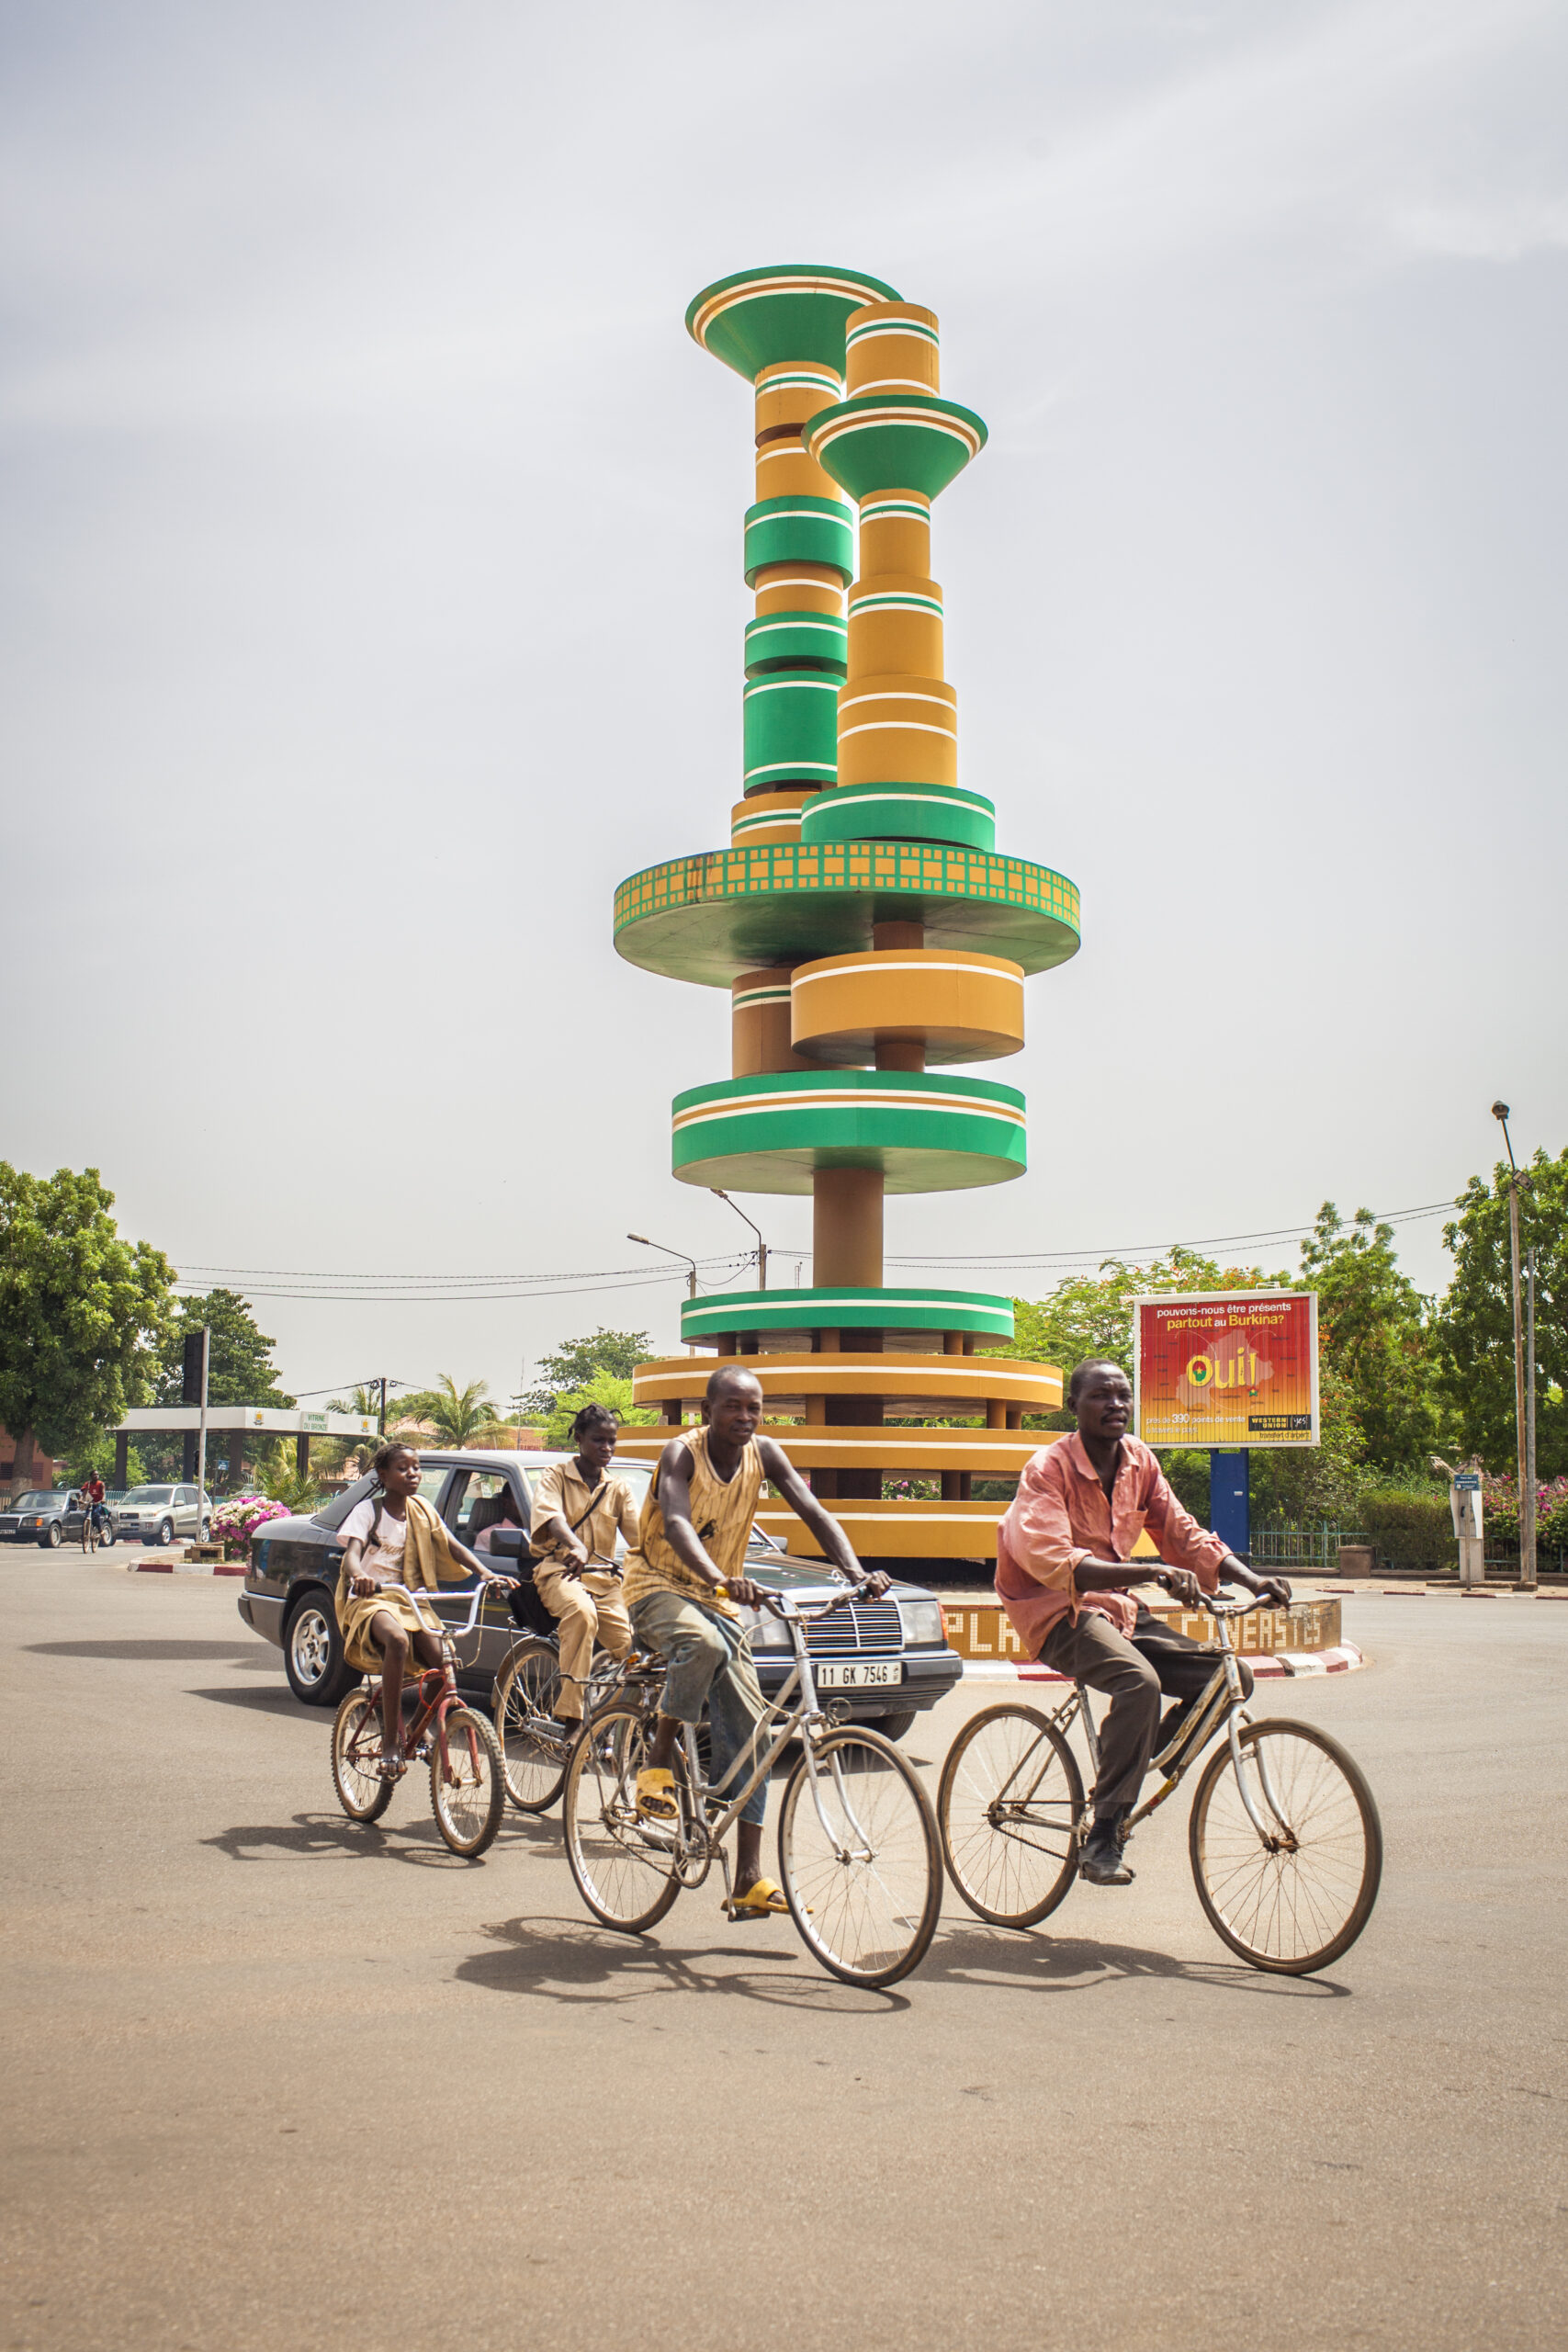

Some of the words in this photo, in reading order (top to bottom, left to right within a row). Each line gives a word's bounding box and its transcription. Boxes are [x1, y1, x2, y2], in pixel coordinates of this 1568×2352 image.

[1156, 1306, 1225, 1319] pouvons-nous
[1227, 1304, 1247, 1314] être
[1248, 1302, 1292, 1315] présents
[1167, 1316, 1213, 1331] partout
[1213, 1318, 1227, 1327] au
[1228, 1313, 1284, 1327] Burkina?
[1186, 1346, 1258, 1397] Oui!
[308, 1414, 326, 1422] VITRINE
[1171, 1413, 1190, 1424] 390
[1191, 1416, 1213, 1425] points
[1214, 1415, 1224, 1423] de
[1225, 1415, 1246, 1423] vente
[822, 1668, 835, 1685] 11
[842, 1667, 857, 1685] GK
[863, 1666, 888, 1684] 7546
